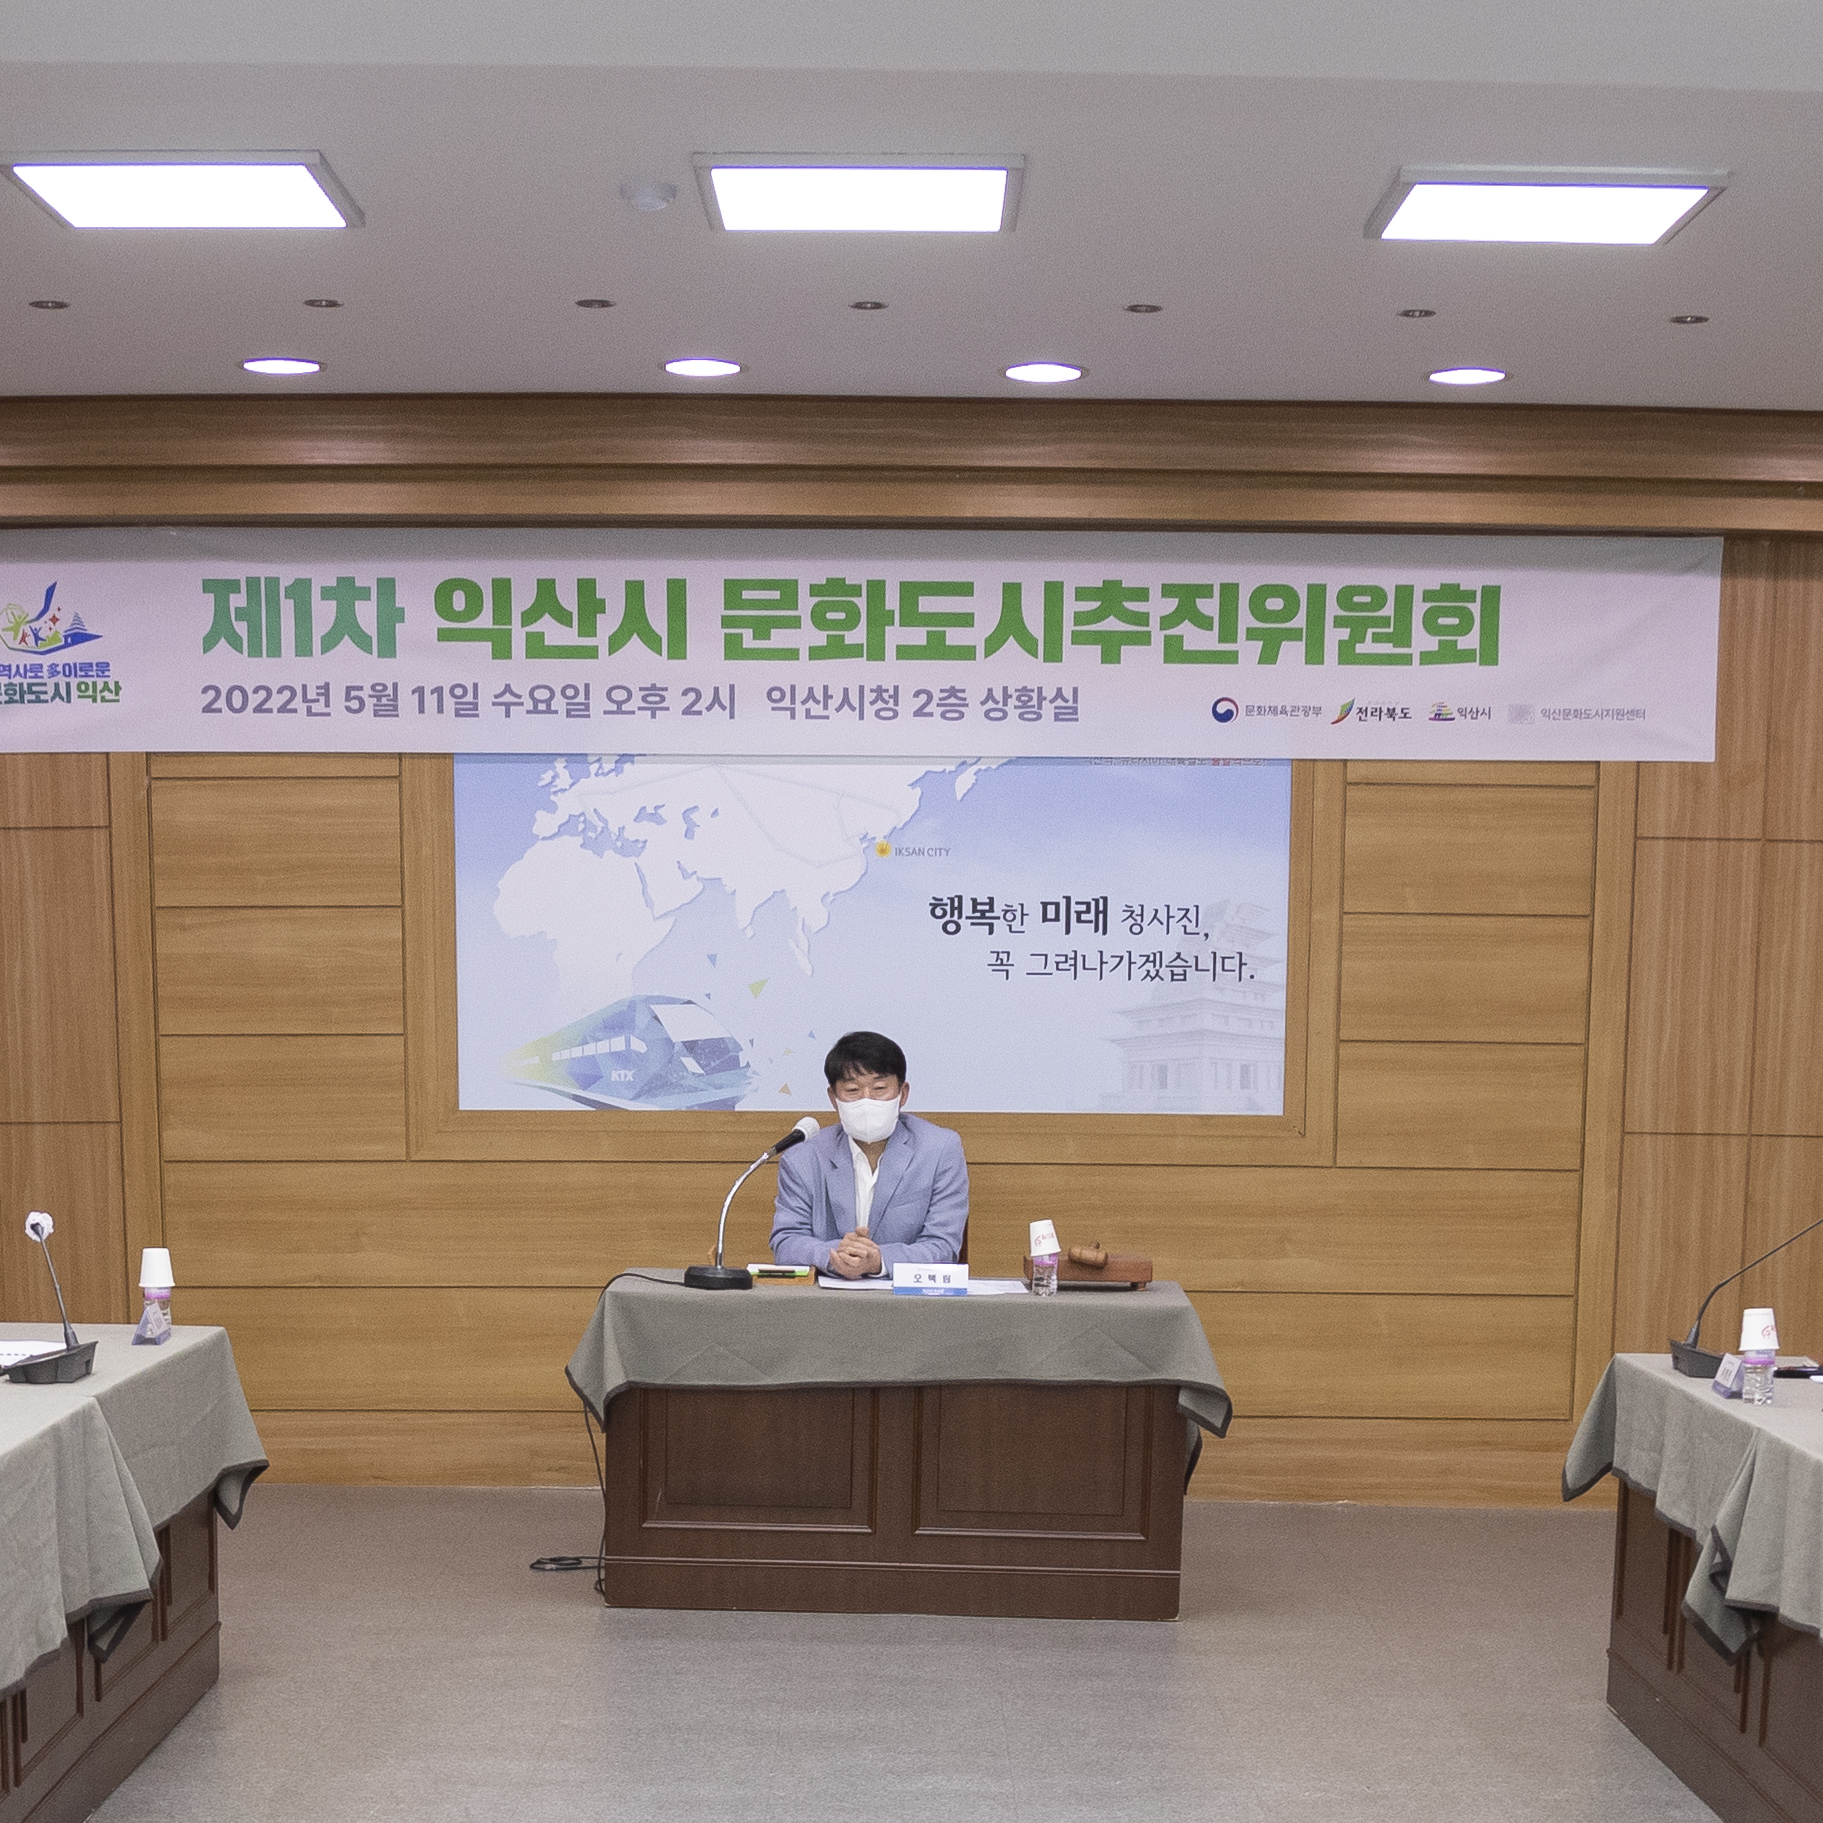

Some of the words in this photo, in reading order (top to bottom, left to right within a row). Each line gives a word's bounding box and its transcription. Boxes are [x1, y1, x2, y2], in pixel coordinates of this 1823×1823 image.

[202, 577, 403, 658] 제1차
[434, 578, 687, 660] 익산시
[721, 578, 1502, 667] 문화도시추진위원회
[77, 681, 122, 703] 익산
[201, 682, 331, 717] 2022년
[344, 683, 399, 718] 5월
[411, 683, 480, 718] 11일
[491, 683, 591, 719] 수요일
[603, 684, 670, 719] 오후
[681, 685, 735, 720] 2시
[766, 685, 900, 721] 익산시청
[912, 686, 969, 721] 2층
[980, 687, 1080, 722] 상황실
[1245, 704, 1323, 718] 문화체육관광부
[1356, 706, 1413, 722] 전라북도
[1457, 706, 1492, 720] 익산시
[895, 847, 925, 857] IKSAN
[927, 847, 951, 857] CITY
[928, 895, 1030, 937] 행복한
[1040, 895, 1110, 937] 미래
[1121, 903, 1211, 942] 청사진,
[987, 950, 1015, 981] 꼭
[1026, 950, 1256, 983] 그려나가겠습니다.
[610, 1070, 634, 1081] KTX
